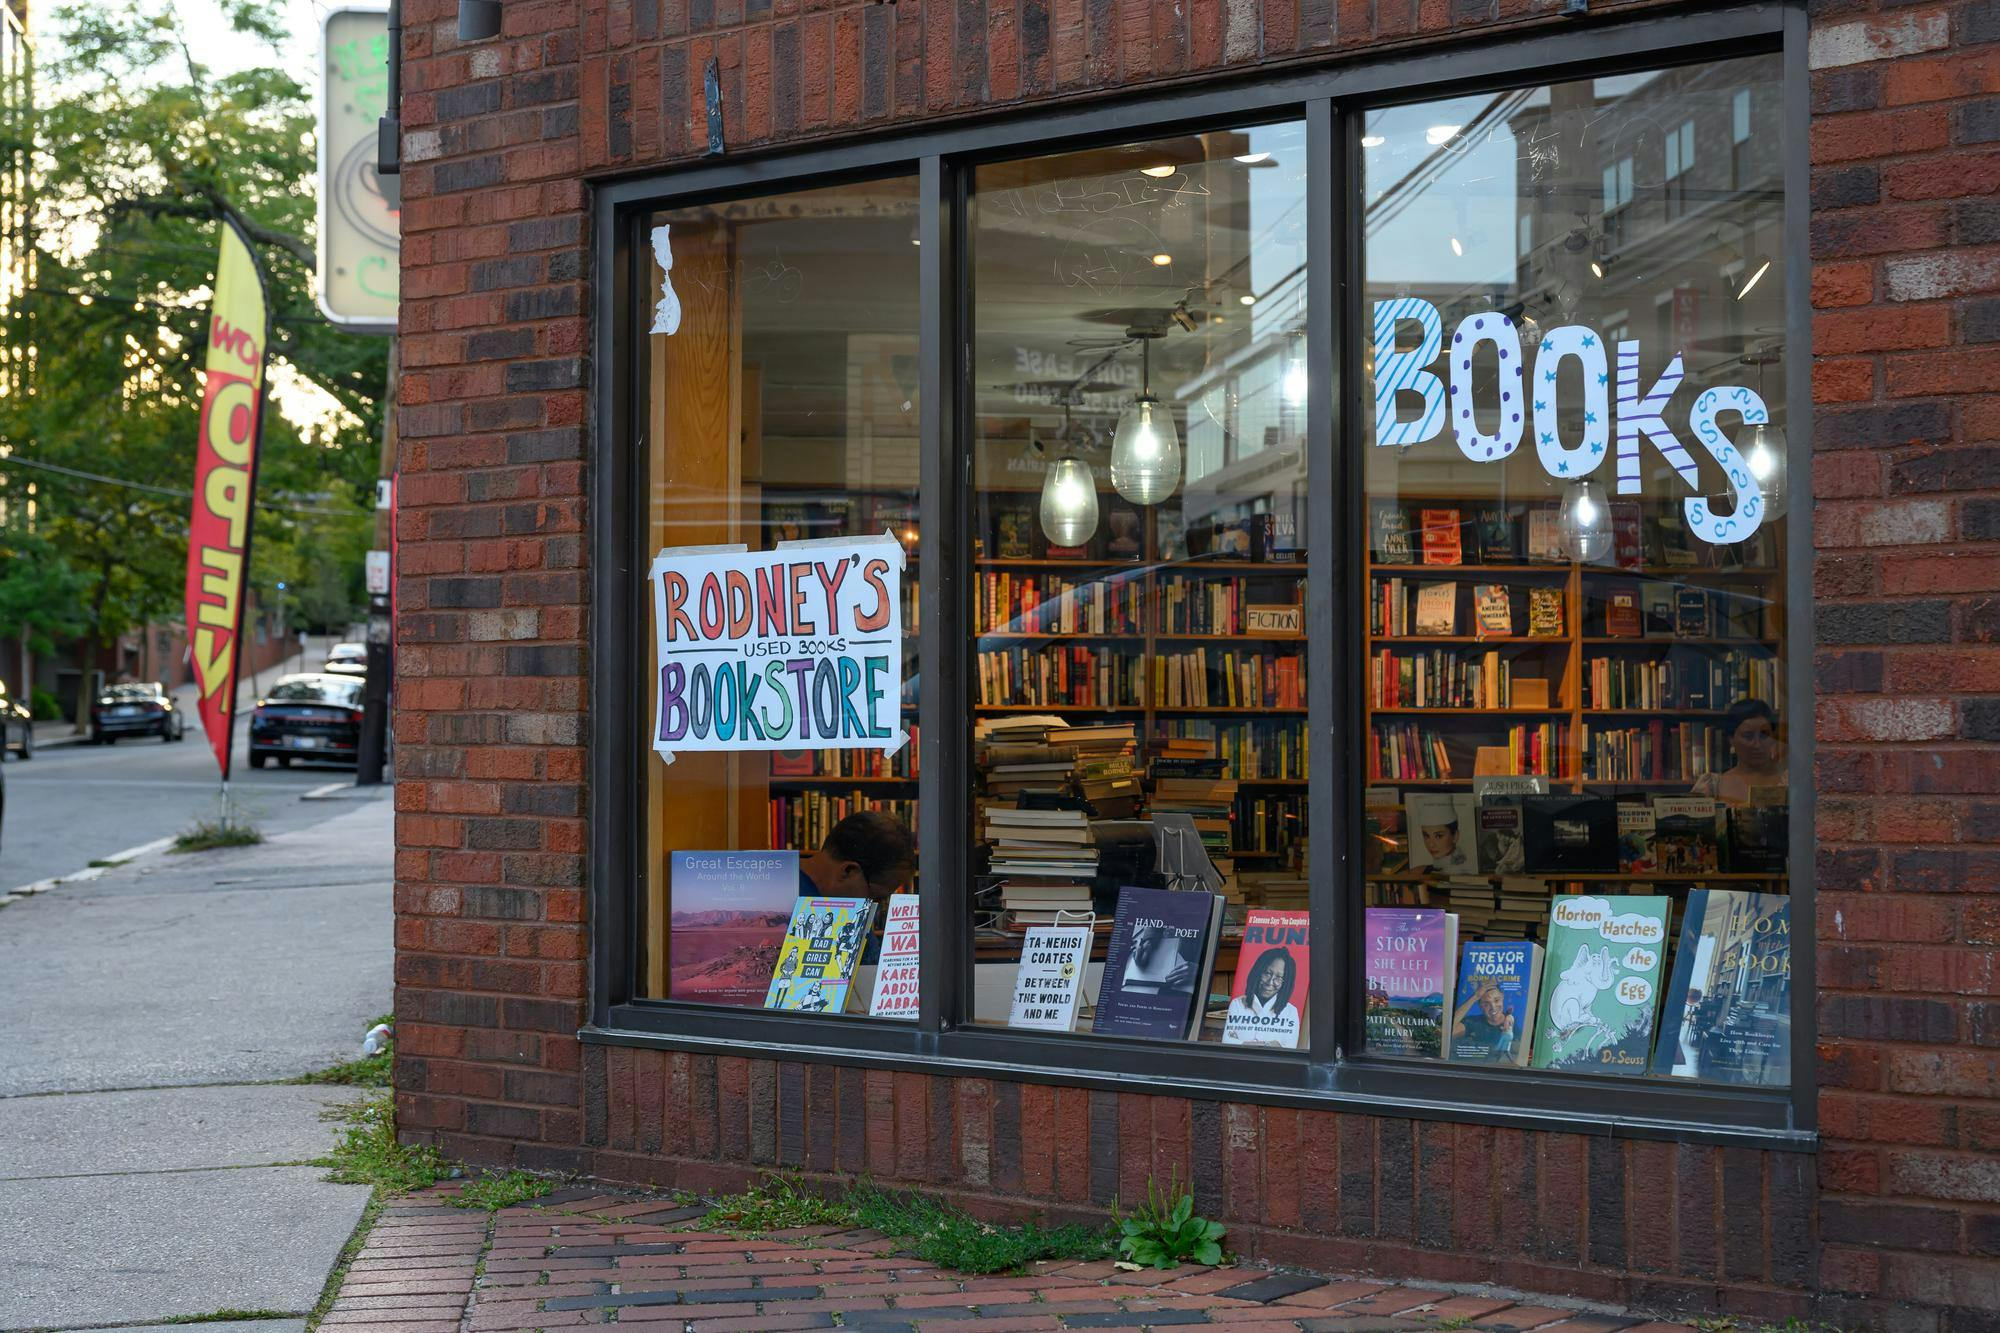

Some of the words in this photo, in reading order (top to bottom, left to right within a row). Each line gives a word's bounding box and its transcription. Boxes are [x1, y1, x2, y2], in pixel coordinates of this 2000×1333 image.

[1374, 297, 1769, 544] BOOKS
[1264, 513, 1294, 522] DANIEL
[1264, 523, 1295, 535] SILVA
[663, 553, 891, 642] RODNEY'S
[1247, 611, 1298, 629] FICTION
[744, 641, 791, 657] USED
[798, 638, 847, 655] BOOKS
[659, 655, 892, 742] BOOKSTORE
[685, 856, 721, 869] Great
[727, 856, 783, 871] Escapes
[697, 872, 727, 881] Around
[730, 872, 743, 881] the
[745, 872, 771, 881] World
[1556, 904, 1602, 921] Horton
[902, 921, 914, 930] ON
[1134, 917, 1164, 929] HAND
[1603, 920, 1658, 937] Hatches
[1174, 928, 1199, 938] POET
[813, 940, 829, 948] RAD
[1029, 937, 1082, 949] TA-NEHISI
[1376, 936, 1428, 952] STORY
[806, 953, 828, 962] GIRLS
[1031, 952, 1073, 964] COATES
[1469, 951, 1525, 963] TREVOR
[1630, 949, 1652, 966] the
[1374, 958, 1396, 970] SHE
[1402, 959, 1429, 971] LEFT
[1476, 963, 1516, 975] NOAH
[805, 968, 820, 976] CAN
[881, 967, 919, 981] KARE
[880, 981, 919, 996] ABDU
[1024, 977, 1070, 989] BETWEEN
[1368, 975, 1434, 993] BEHIND
[1620, 982, 1648, 1000] Egg
[1018, 993, 1036, 1003] THE
[1039, 993, 1071, 1004] WORLD
[1023, 1009, 1042, 1019] AND
[1044, 1009, 1059, 1020] ME
[1228, 1015, 1295, 1027] WHOOPI's
[1390, 1016, 1436, 1027] CALLAHAN
[1254, 1026, 1293, 1034] RELATIONSHIPS
[1384, 1027, 1414, 1037] HENRY
[1617, 1050, 1645, 1065] Seuss
